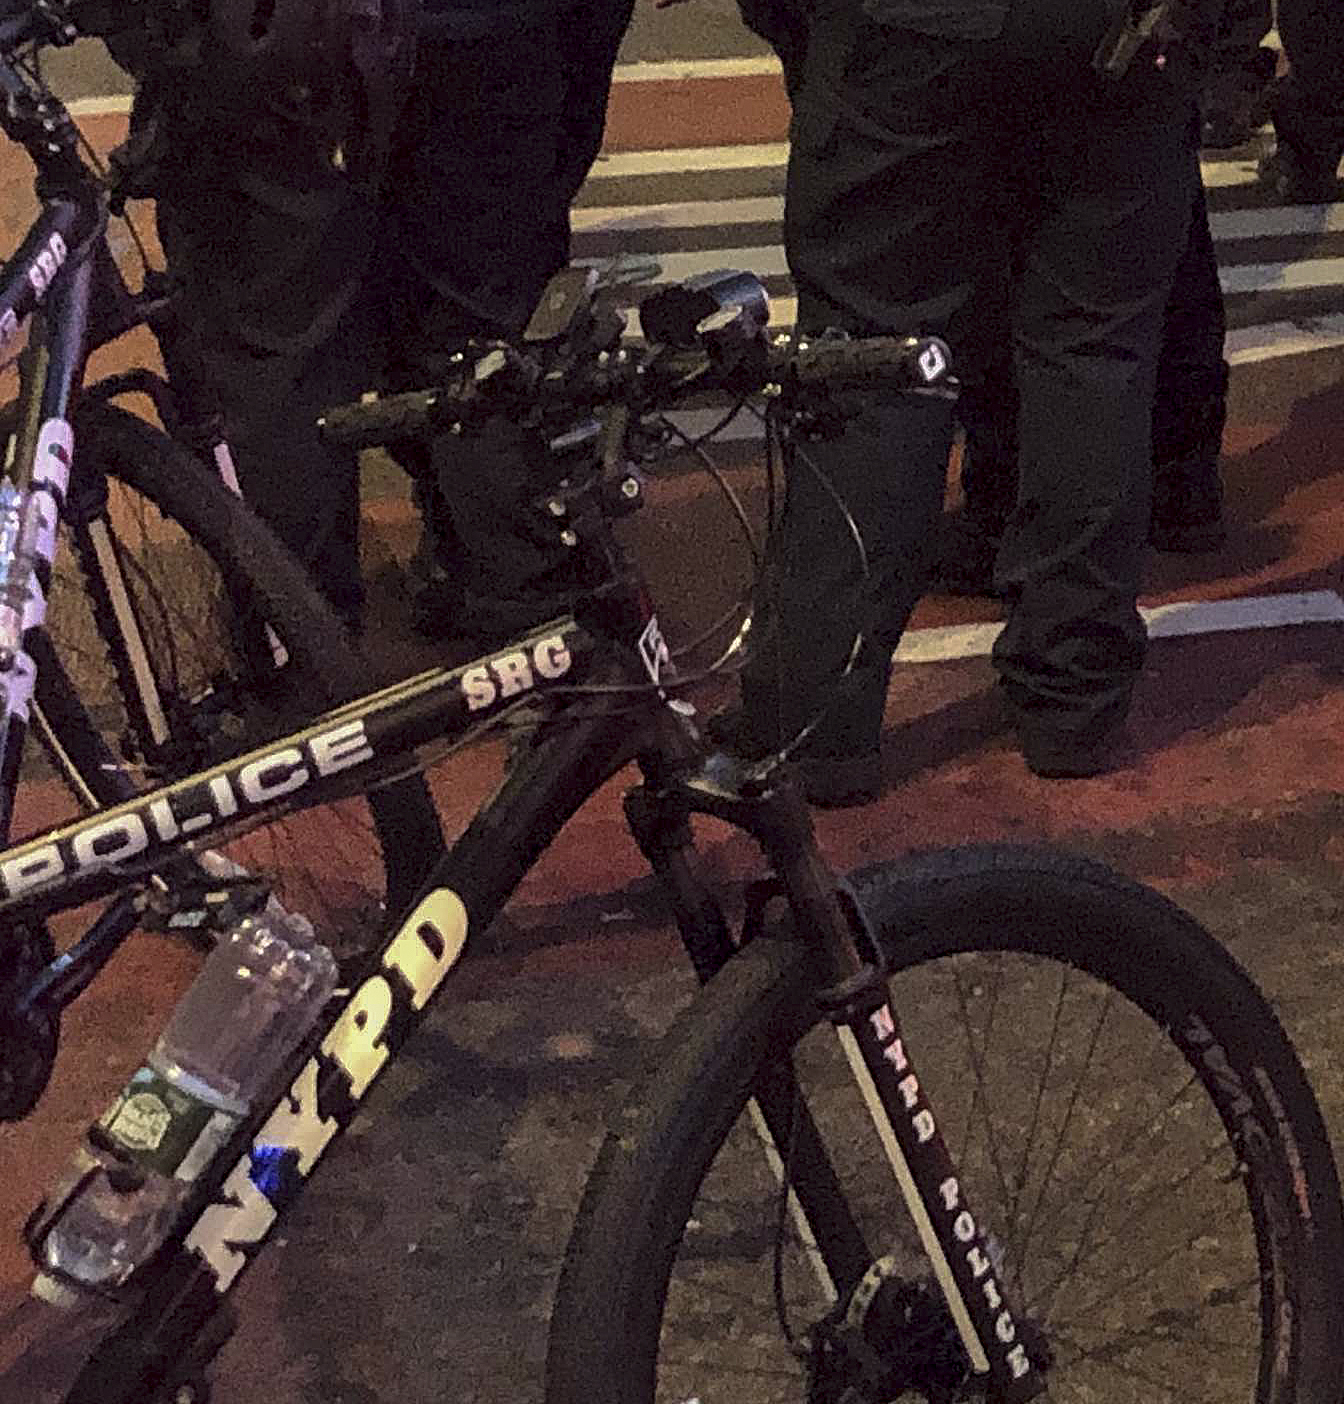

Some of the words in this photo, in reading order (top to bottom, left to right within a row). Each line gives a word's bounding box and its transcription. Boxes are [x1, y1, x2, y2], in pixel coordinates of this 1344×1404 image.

[1, 719, 375, 896] POLICE
[459, 634, 572, 712] SRG
[182, 887, 469, 1294] NYPD
[868, 1003, 936, 1143] NYPD
[938, 1176, 1030, 1378] POLICE
